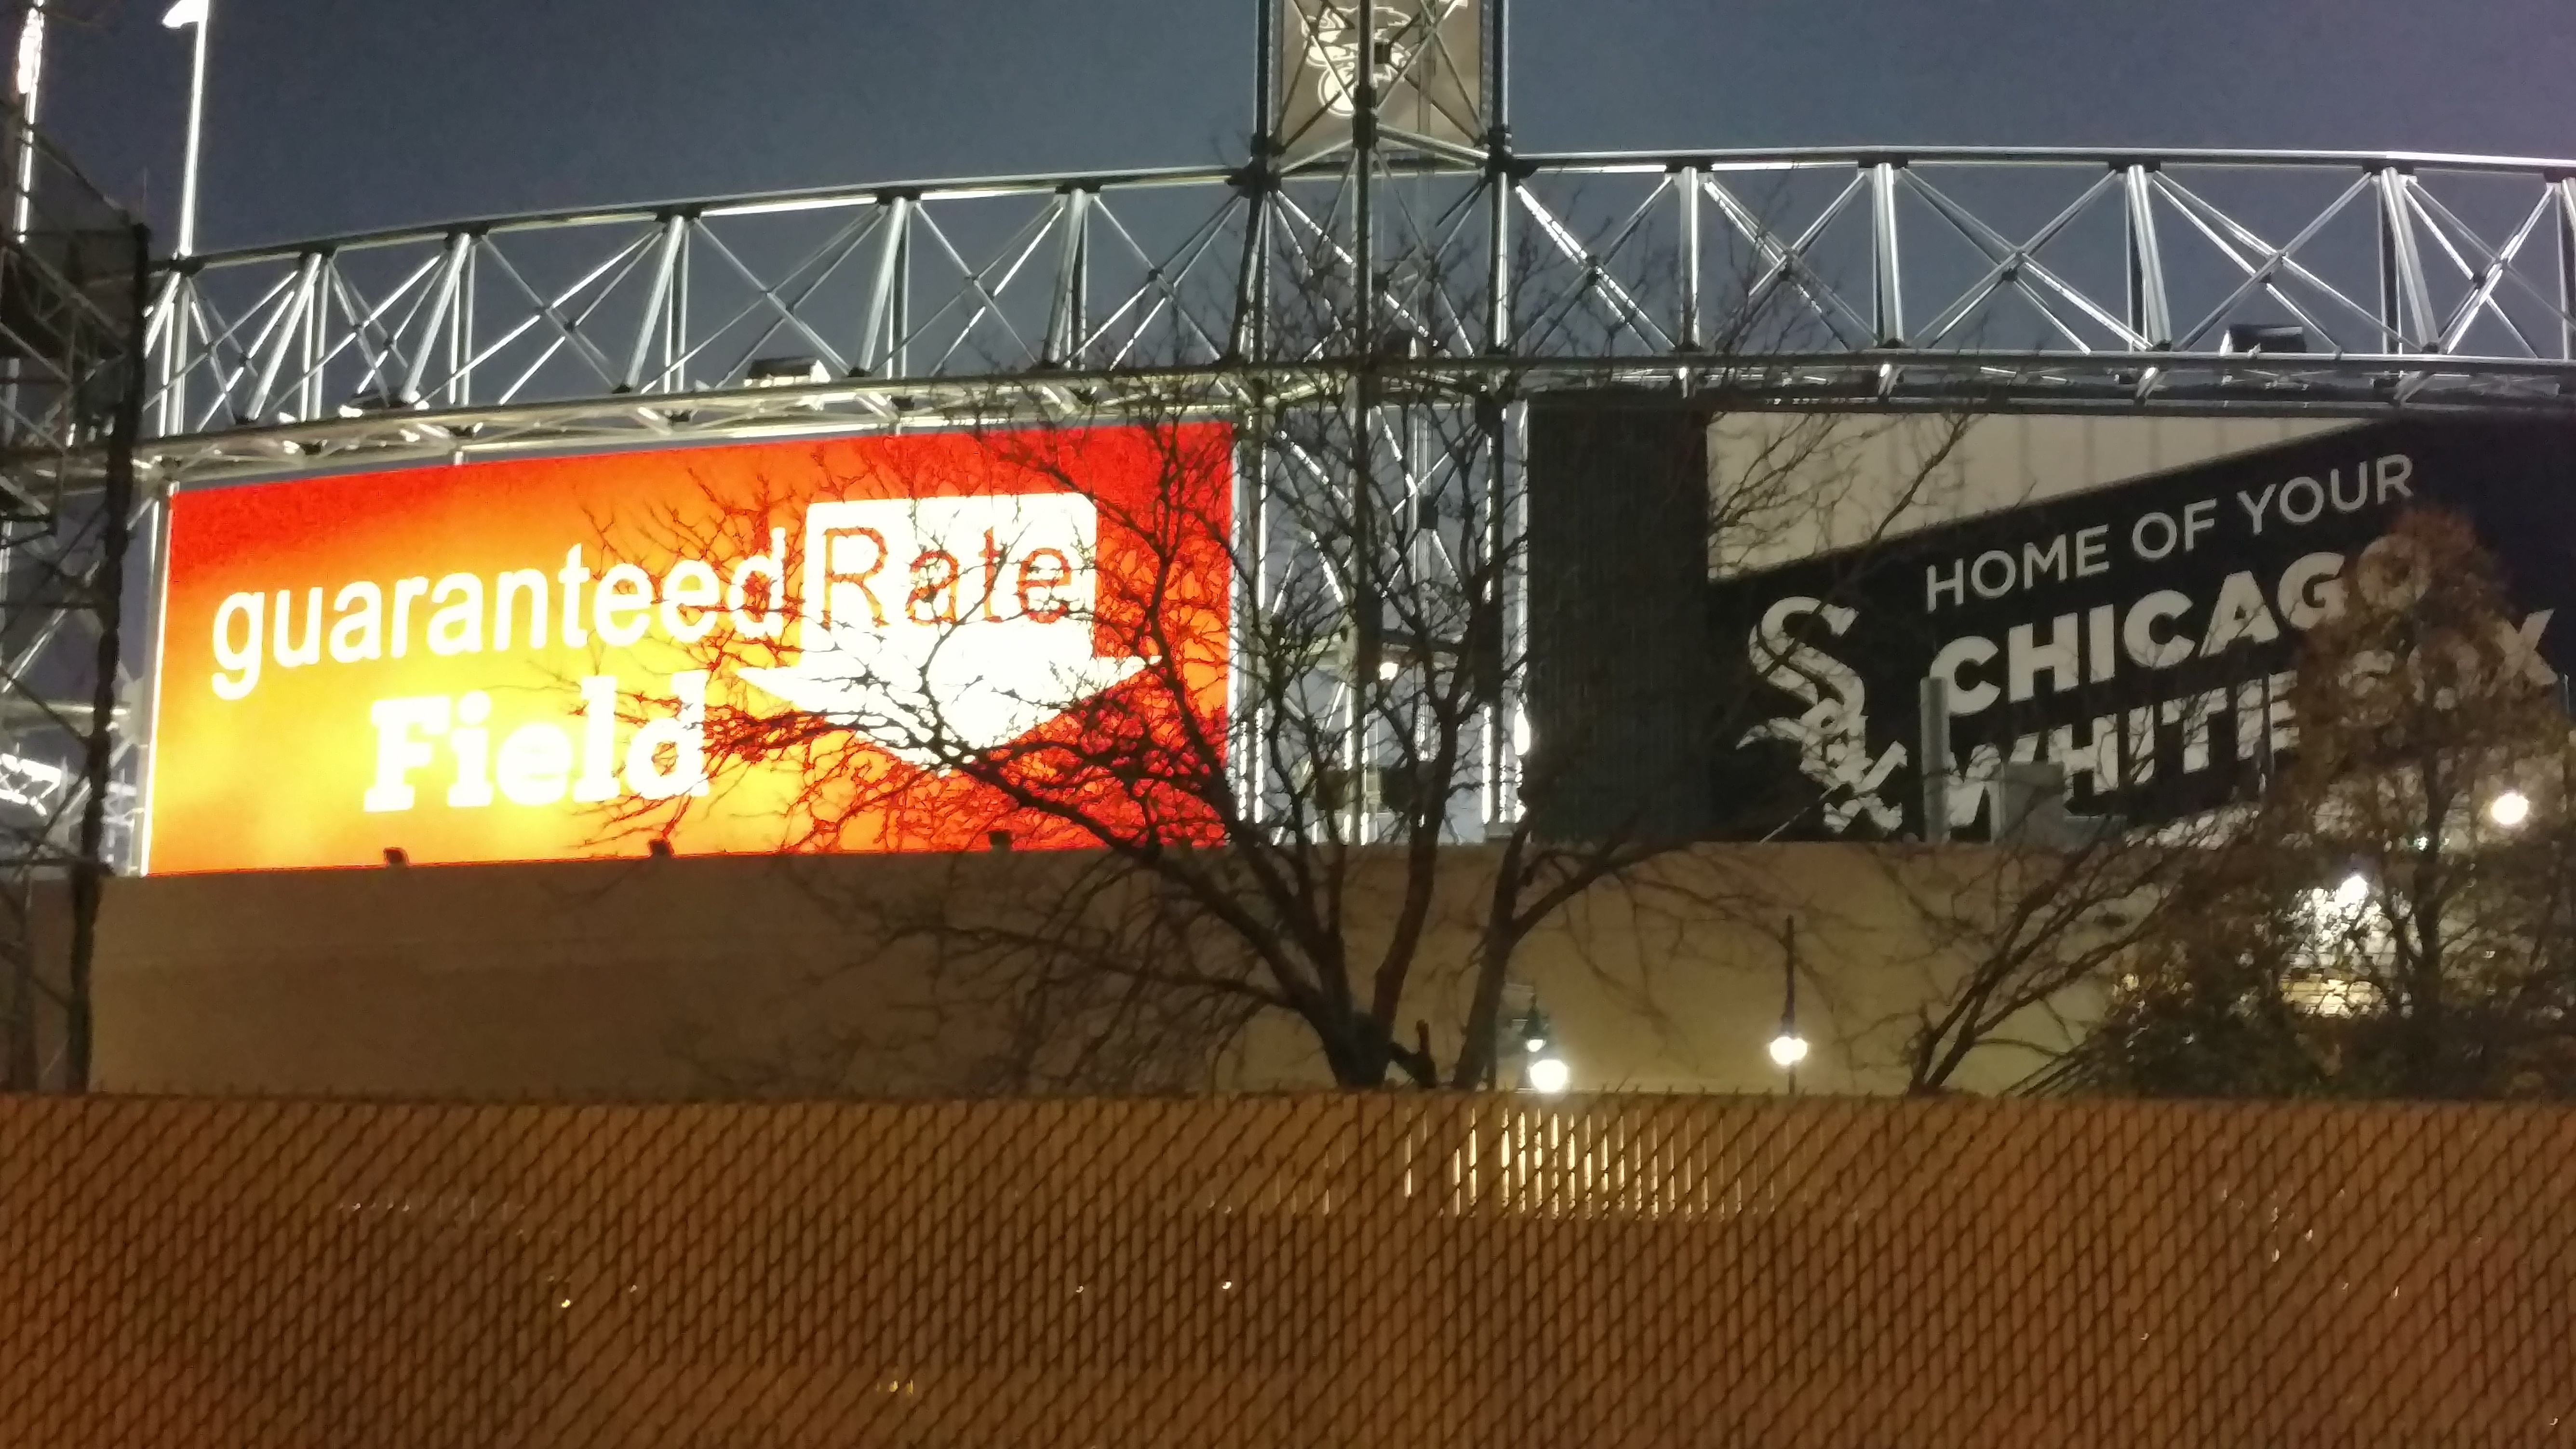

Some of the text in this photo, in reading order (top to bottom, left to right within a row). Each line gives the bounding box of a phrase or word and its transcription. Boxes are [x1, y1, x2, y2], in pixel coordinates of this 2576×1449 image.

[210, 526, 1073, 699] guaranteed Rate
[1925, 454, 2413, 612] HOME OF YOUR
[1929, 534, 2431, 716] CHICAGO
[364, 670, 711, 813] Field
